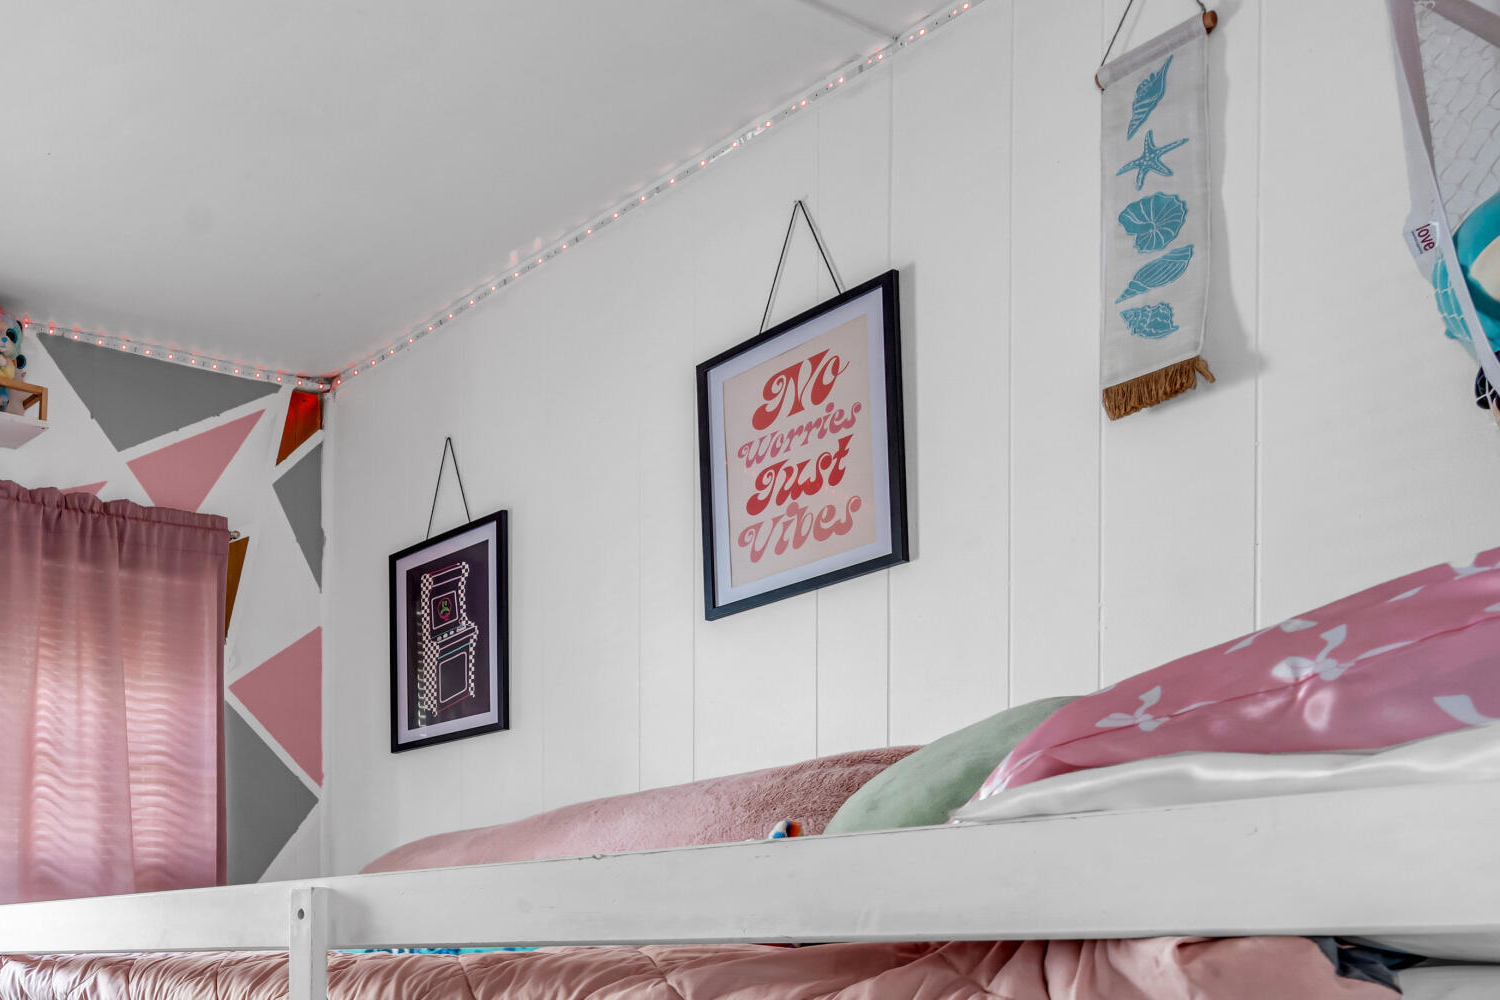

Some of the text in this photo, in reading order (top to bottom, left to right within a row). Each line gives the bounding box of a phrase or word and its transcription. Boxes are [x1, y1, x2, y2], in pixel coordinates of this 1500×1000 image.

[751, 348, 850, 431] No
[737, 401, 863, 469] Worries
[746, 433, 854, 516] Just
[737, 495, 863, 563] Vibes
